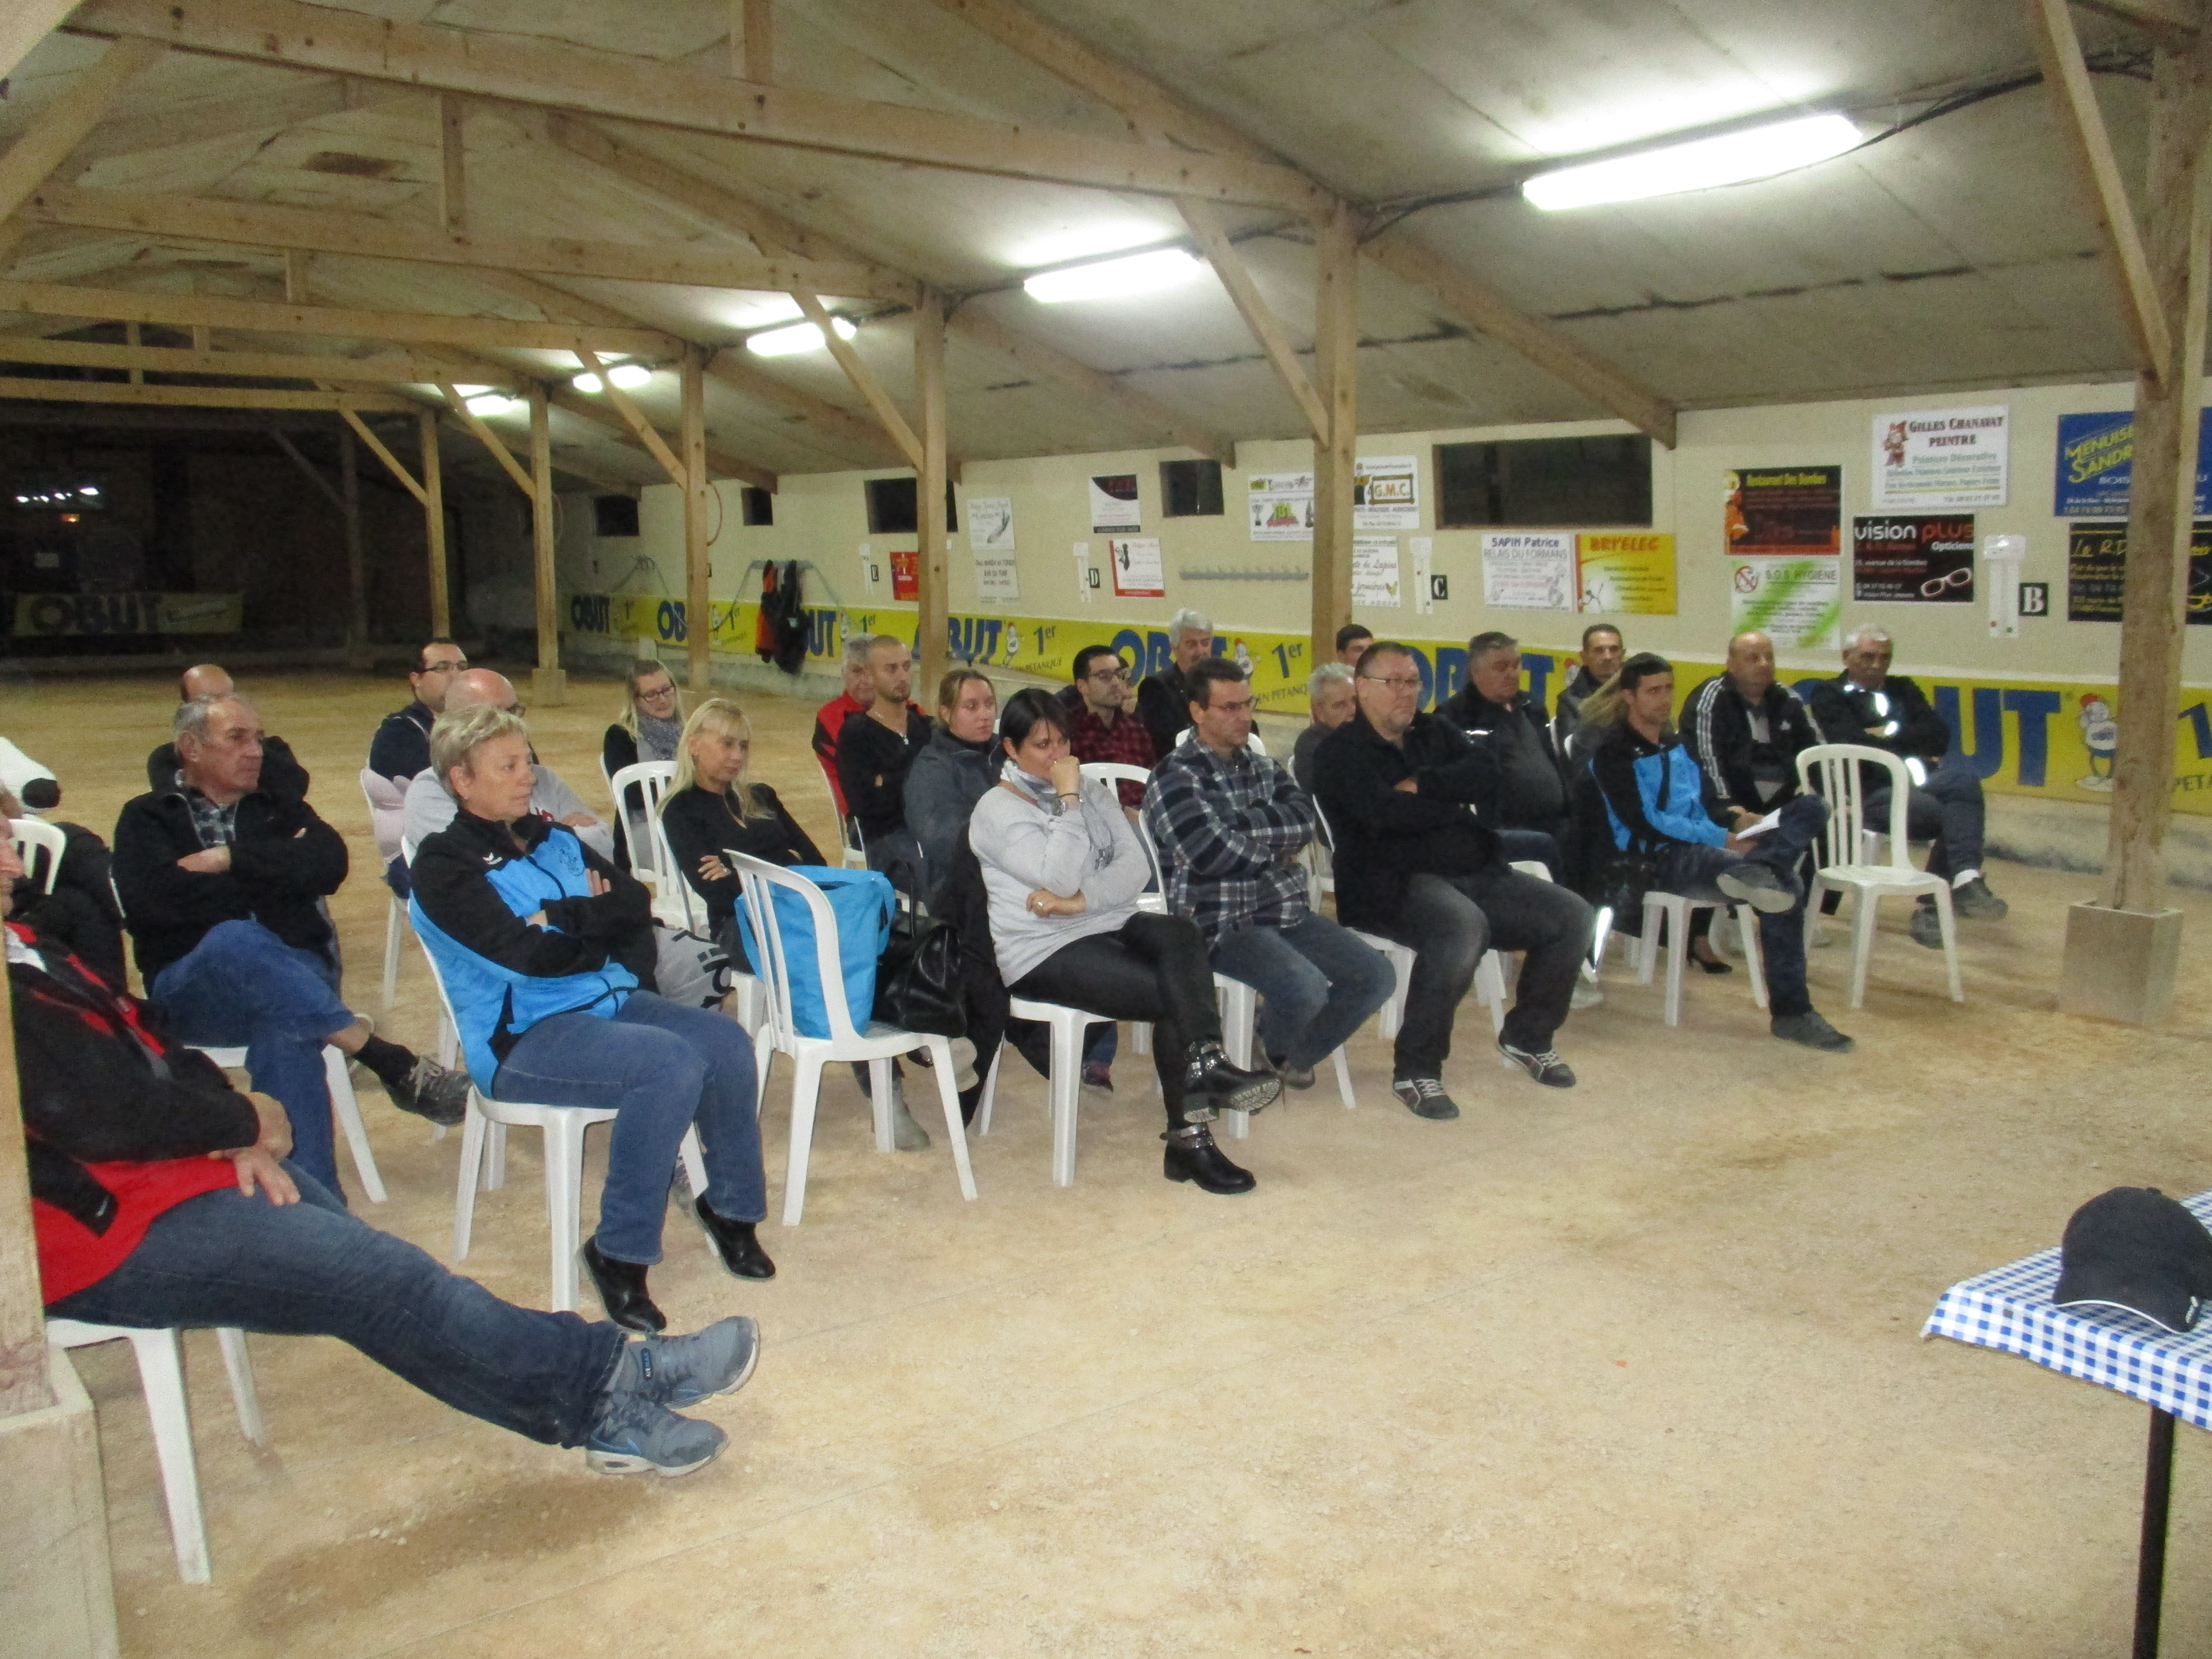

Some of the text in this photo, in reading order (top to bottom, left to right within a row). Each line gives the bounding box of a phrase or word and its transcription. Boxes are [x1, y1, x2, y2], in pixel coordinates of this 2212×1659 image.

[1909, 421, 1945, 432] GILLES
[1929, 434, 1976, 447] PEINTRE
[2065, 426, 2133, 459] MENUISE
[2069, 444, 2133, 483] SANDR
[1525, 537, 1559, 547] Patrice
[1855, 520, 1974, 544] vision plus
[2100, 539, 2127, 555] RD
[1091, 570, 1098, 585] D
[1434, 578, 1445, 597] C
[2023, 587, 2044, 613] B
[657, 601, 688, 642] OB
[803, 609, 836, 657] UT
[1033, 625, 1056, 655] 1er
[1272, 642, 1302, 678] 1er
[1272, 684, 1308, 700] PETANQ
